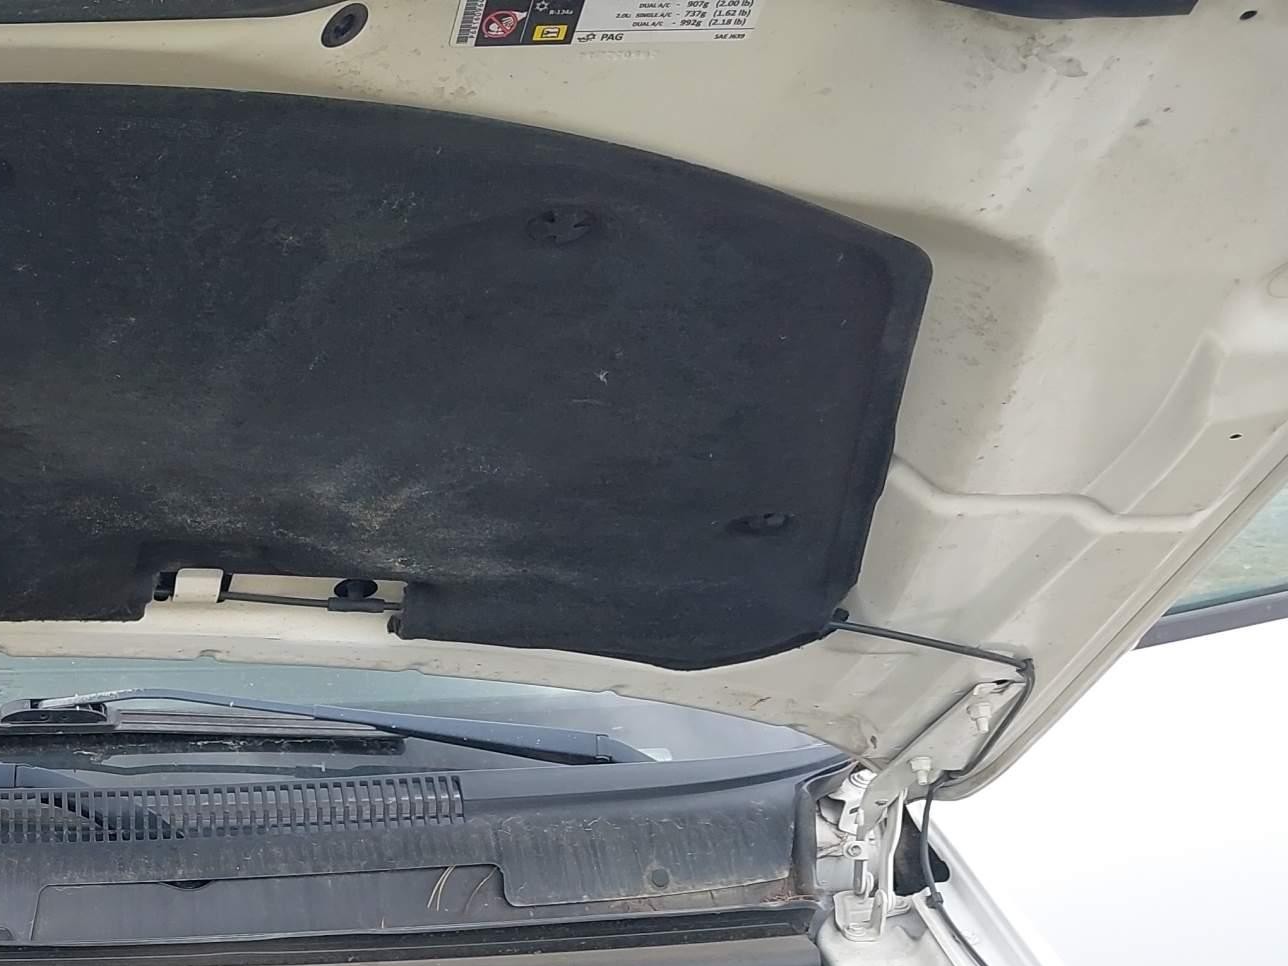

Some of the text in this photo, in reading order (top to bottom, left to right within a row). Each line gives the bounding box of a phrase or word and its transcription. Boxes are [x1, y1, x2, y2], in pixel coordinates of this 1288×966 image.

[687, 0, 710, 8] 907g
[716, 0, 740, 8] (2.00
[740, 0, 754, 8] lb)
[684, 10, 708, 18] 737g
[713, 9, 737, 18] (1.62
[737, 9, 752, 17] lb)
[679, 19, 702, 27] 992g
[708, 19, 733, 27] (2.18
[733, 18, 747, 26] lb)
[600, 33, 624, 41] PAG
